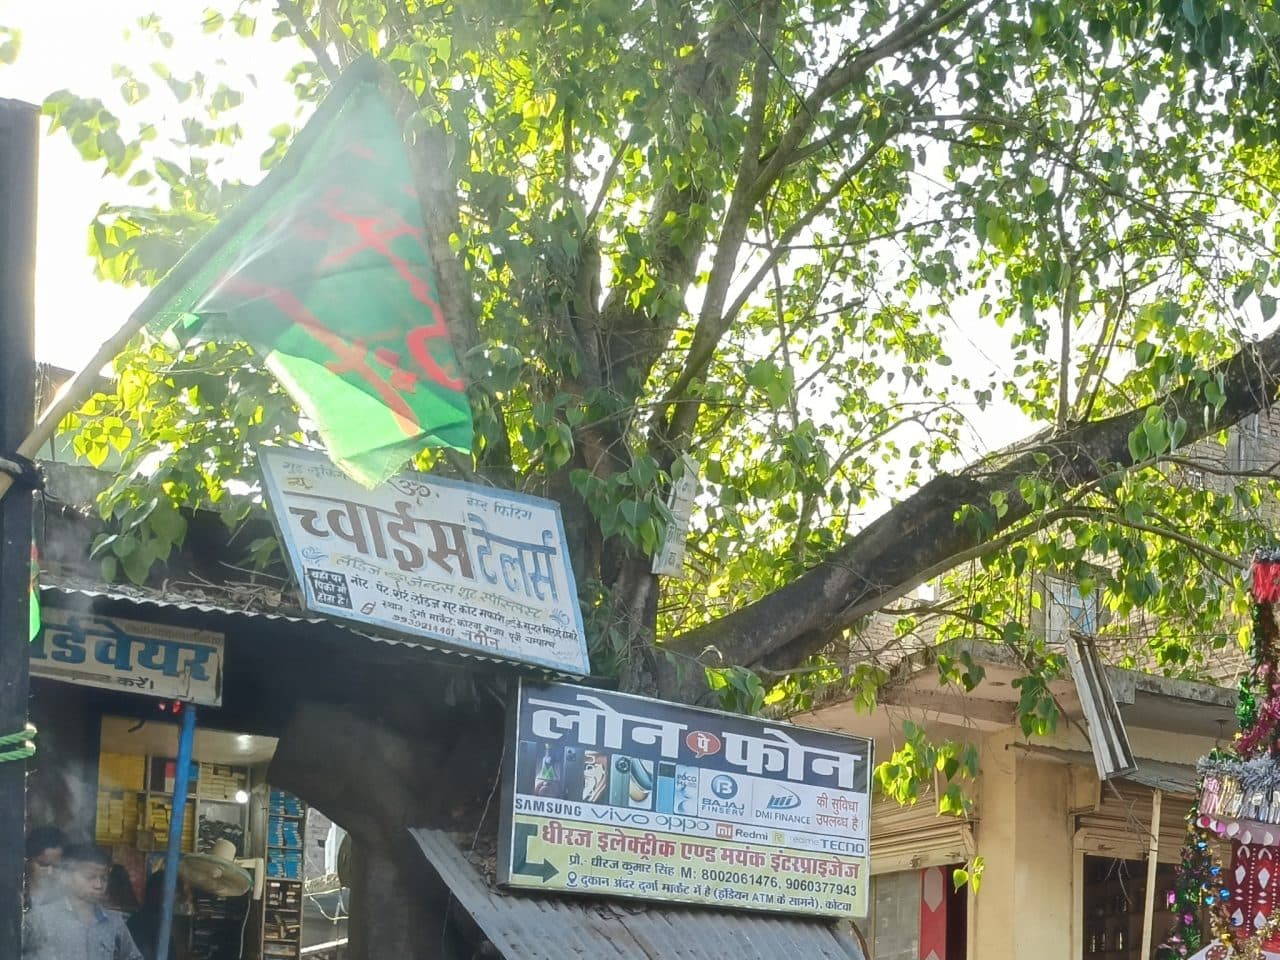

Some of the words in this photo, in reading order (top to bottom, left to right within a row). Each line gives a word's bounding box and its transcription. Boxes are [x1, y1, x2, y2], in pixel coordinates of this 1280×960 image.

[528, 694, 688, 759] लोन
[722, 727, 862, 789] फोन
[515, 798, 582, 817] SAMSUNG
[701, 797, 745, 810] BAJAJ
[701, 804, 745, 816] FINSERV
[816, 792, 829, 809] की
[831, 796, 859, 815] सुविधा
[591, 807, 650, 826] vivo
[655, 815, 710, 833] oppo
[755, 809, 773, 820] DMI
[775, 812, 811, 825] FINANCE
[816, 813, 849, 828] उपलब्ध
[735, 828, 768, 841] Redmi
[542, 820, 593, 848] धीरज
[680, 842, 718, 863] एण्ड
[720, 845, 766, 868] मयंक
[819, 839, 865, 853] TECNO
[591, 856, 619, 870] धीरज
[622, 860, 651, 876] कुमार
[654, 863, 675, 875] सिंह
[786, 878, 857, 897] 9060377943
[581, 874, 610, 888] दुकान
[613, 876, 635, 889] अंदर
[751, 892, 774, 905] ATM
[776, 893, 785, 905] के
[825, 899, 852, 912] कोटवा
